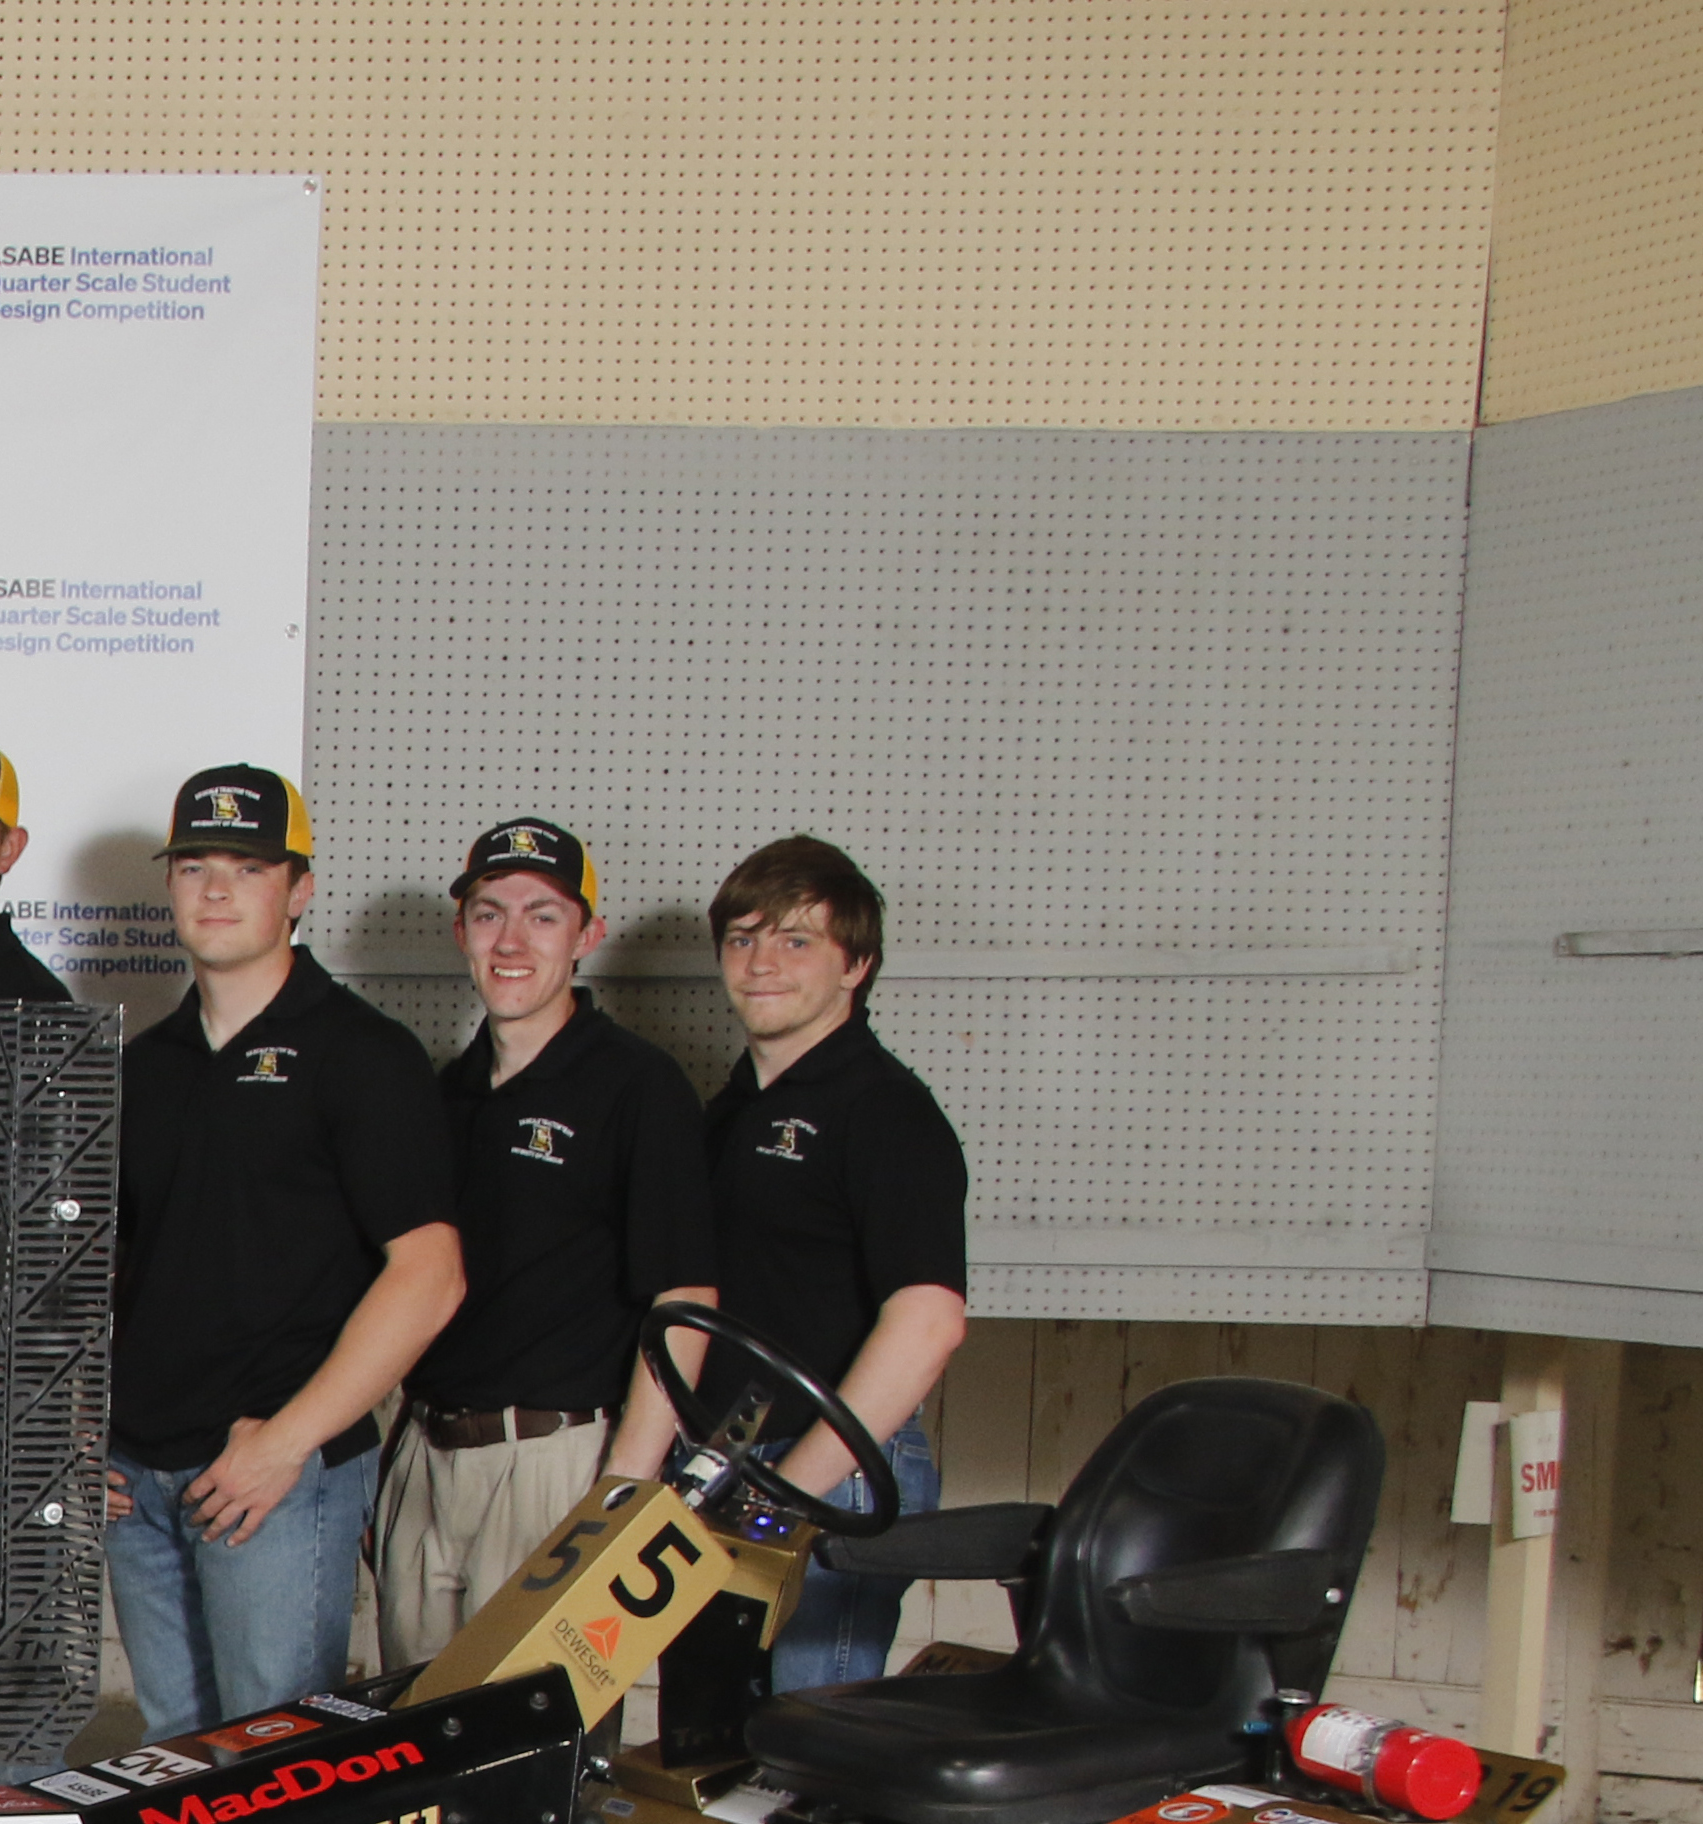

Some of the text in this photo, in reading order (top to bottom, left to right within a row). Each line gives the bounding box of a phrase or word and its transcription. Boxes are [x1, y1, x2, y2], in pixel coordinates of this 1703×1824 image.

[71, 247, 212, 265] International
[76, 272, 137, 292] Scale
[143, 273, 230, 293] Student
[67, 299, 204, 322] Competition
[62, 581, 201, 599] International
[68, 607, 126, 625] Scale
[132, 607, 219, 626] Student
[57, 633, 193, 655] Competition
[58, 928, 119, 947] Scale
[49, 954, 186, 977] Competition
[520, 1520, 608, 1591] 5
[608, 1521, 702, 1619] 5
[109, 1752, 198, 1783] CNH
[1496, 1772, 1559, 1812] 19
